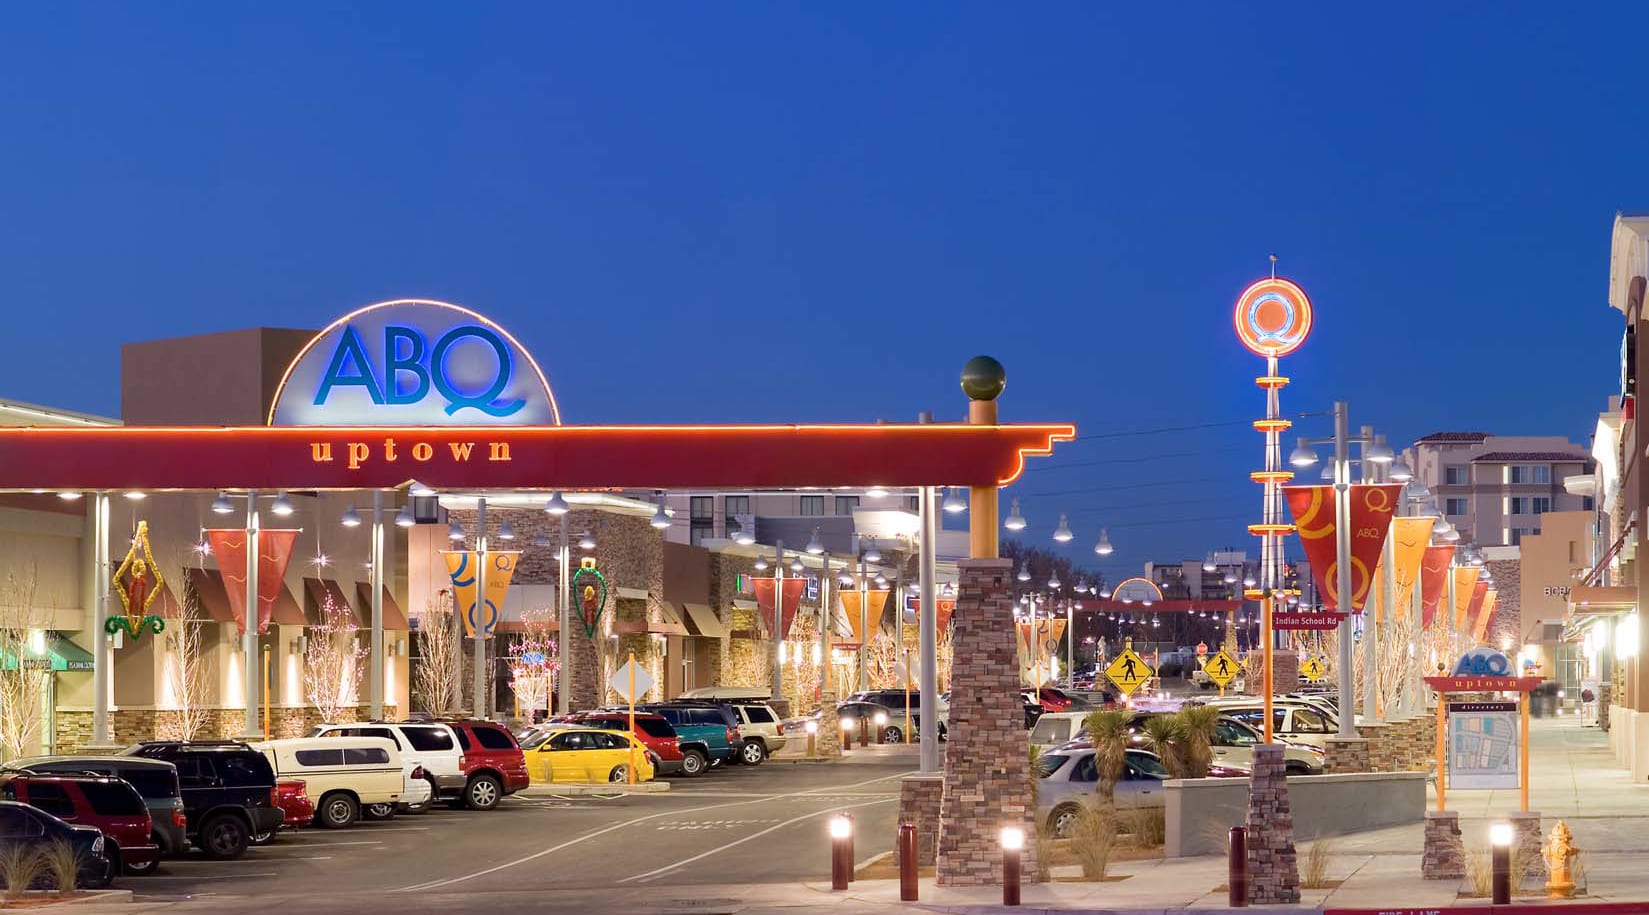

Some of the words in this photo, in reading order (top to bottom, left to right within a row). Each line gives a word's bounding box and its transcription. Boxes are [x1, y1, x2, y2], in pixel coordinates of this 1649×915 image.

[1249, 292, 1302, 344] Q
[312, 324, 527, 417] ABQ
[310, 438, 512, 469] uptown
[1365, 488, 1391, 512] Q
[1356, 528, 1380, 539] ABQ
[495, 555, 512, 571] Q
[1276, 616, 1300, 625] Indian
[1301, 616, 1325, 625] School
[1327, 616, 1337, 625] Rd
[1455, 652, 1510, 677] ABQ
[1455, 679, 1517, 689] uptown
